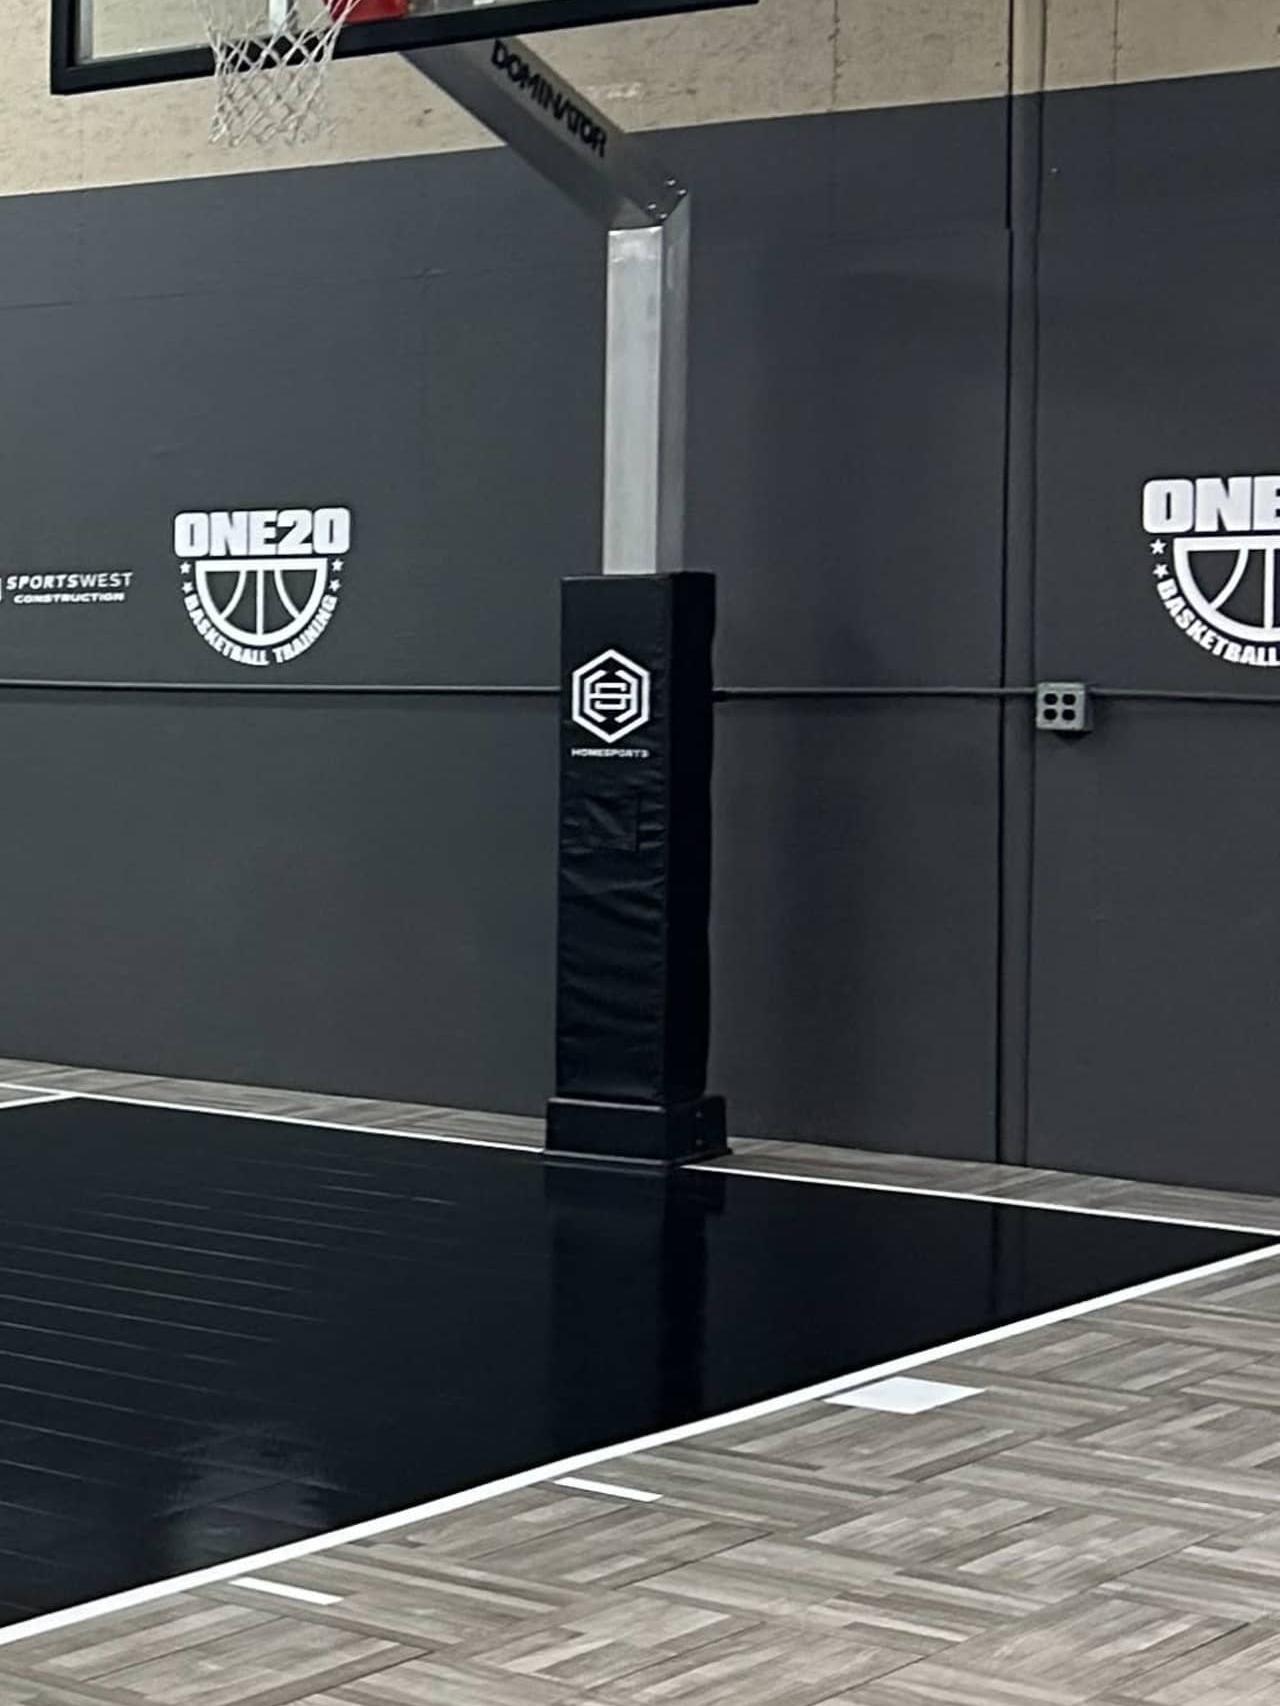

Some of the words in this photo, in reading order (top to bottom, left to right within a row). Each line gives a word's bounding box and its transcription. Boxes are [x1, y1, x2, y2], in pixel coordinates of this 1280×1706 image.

[174, 507, 350, 558] ONE20
[6, 572, 133, 591] SPORTSWEST
[13, 592, 125, 604] CONSTRUCTION
[183, 593, 270, 666] BASKETBALL
[272, 594, 338, 664] TRAINING
